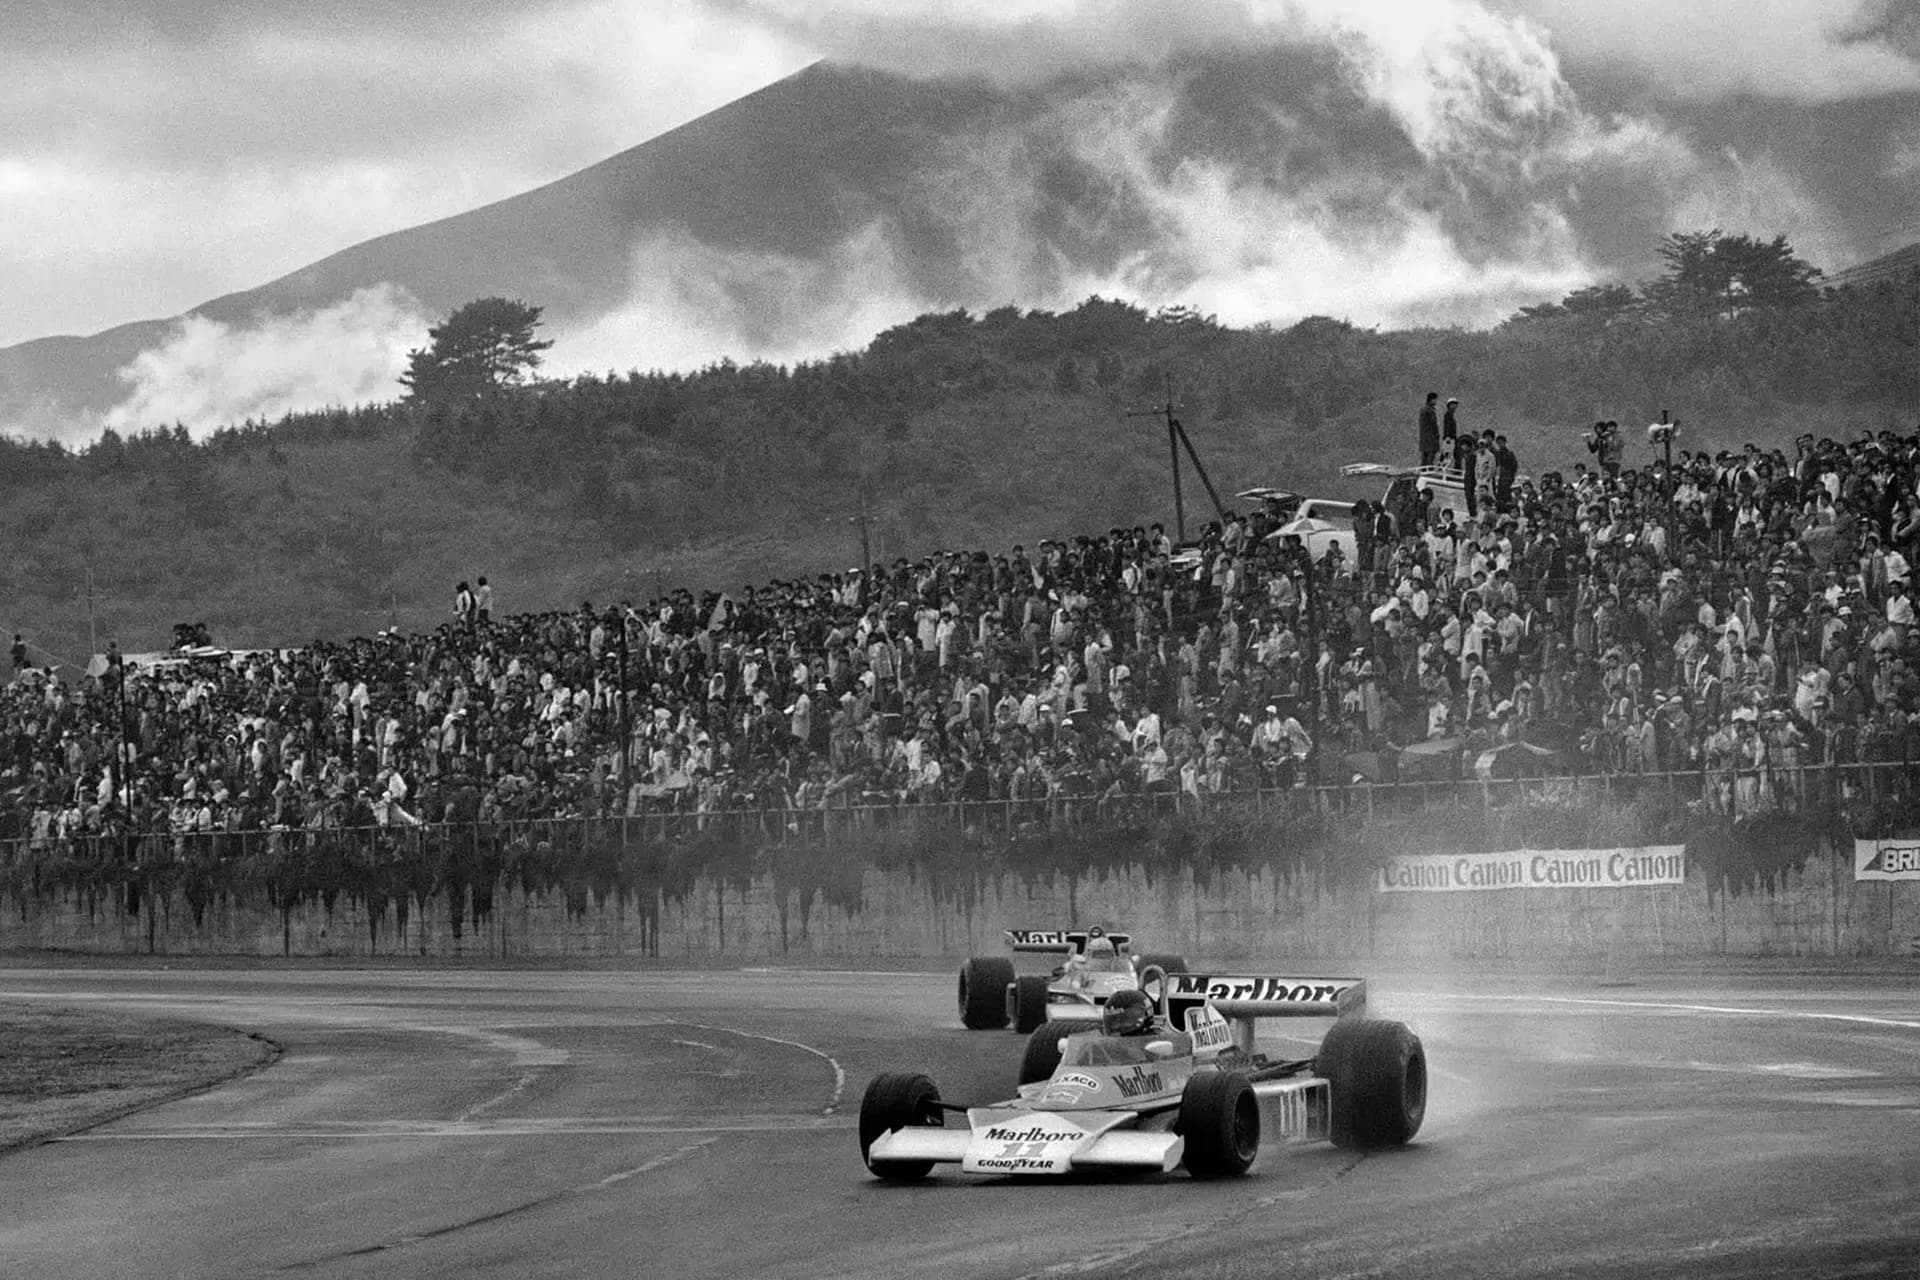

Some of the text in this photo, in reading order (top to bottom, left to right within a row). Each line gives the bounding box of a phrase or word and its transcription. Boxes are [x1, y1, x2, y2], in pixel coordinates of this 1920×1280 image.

[1384, 853, 1681, 887] Canon Canon Canon Canon
[1883, 847, 1920, 873] BRI
[1012, 930, 1067, 943] Marl
[1112, 1066, 1162, 1098] Marlboro
[985, 1127, 1083, 1141] Marlboro
[995, 1143, 1048, 1158] 11
